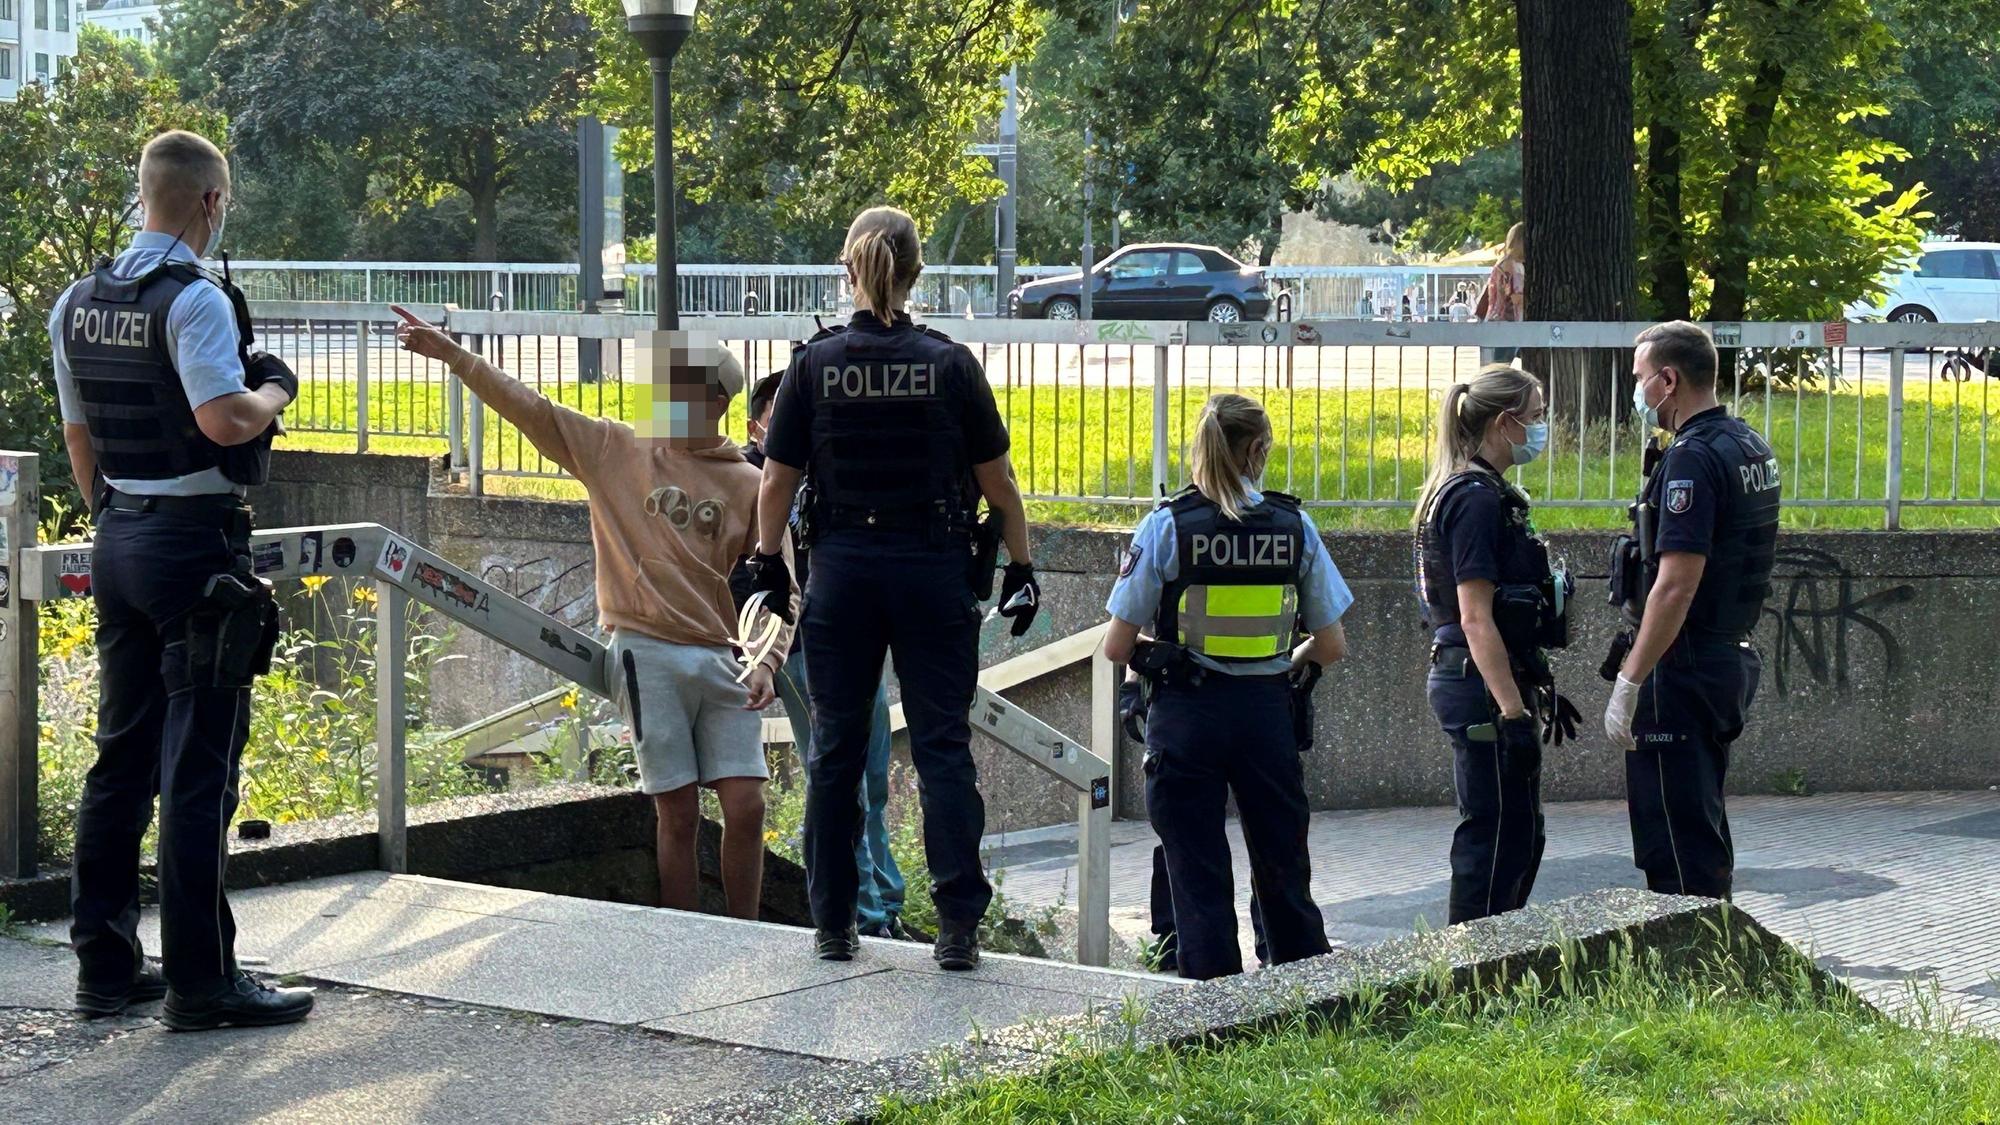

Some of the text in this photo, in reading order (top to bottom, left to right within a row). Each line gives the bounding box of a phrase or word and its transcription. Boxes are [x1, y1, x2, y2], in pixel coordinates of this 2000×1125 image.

[71, 306, 151, 348] POLIZEI
[823, 363, 936, 398] POLIZEI
[1192, 533, 1295, 566] POLIZEI
